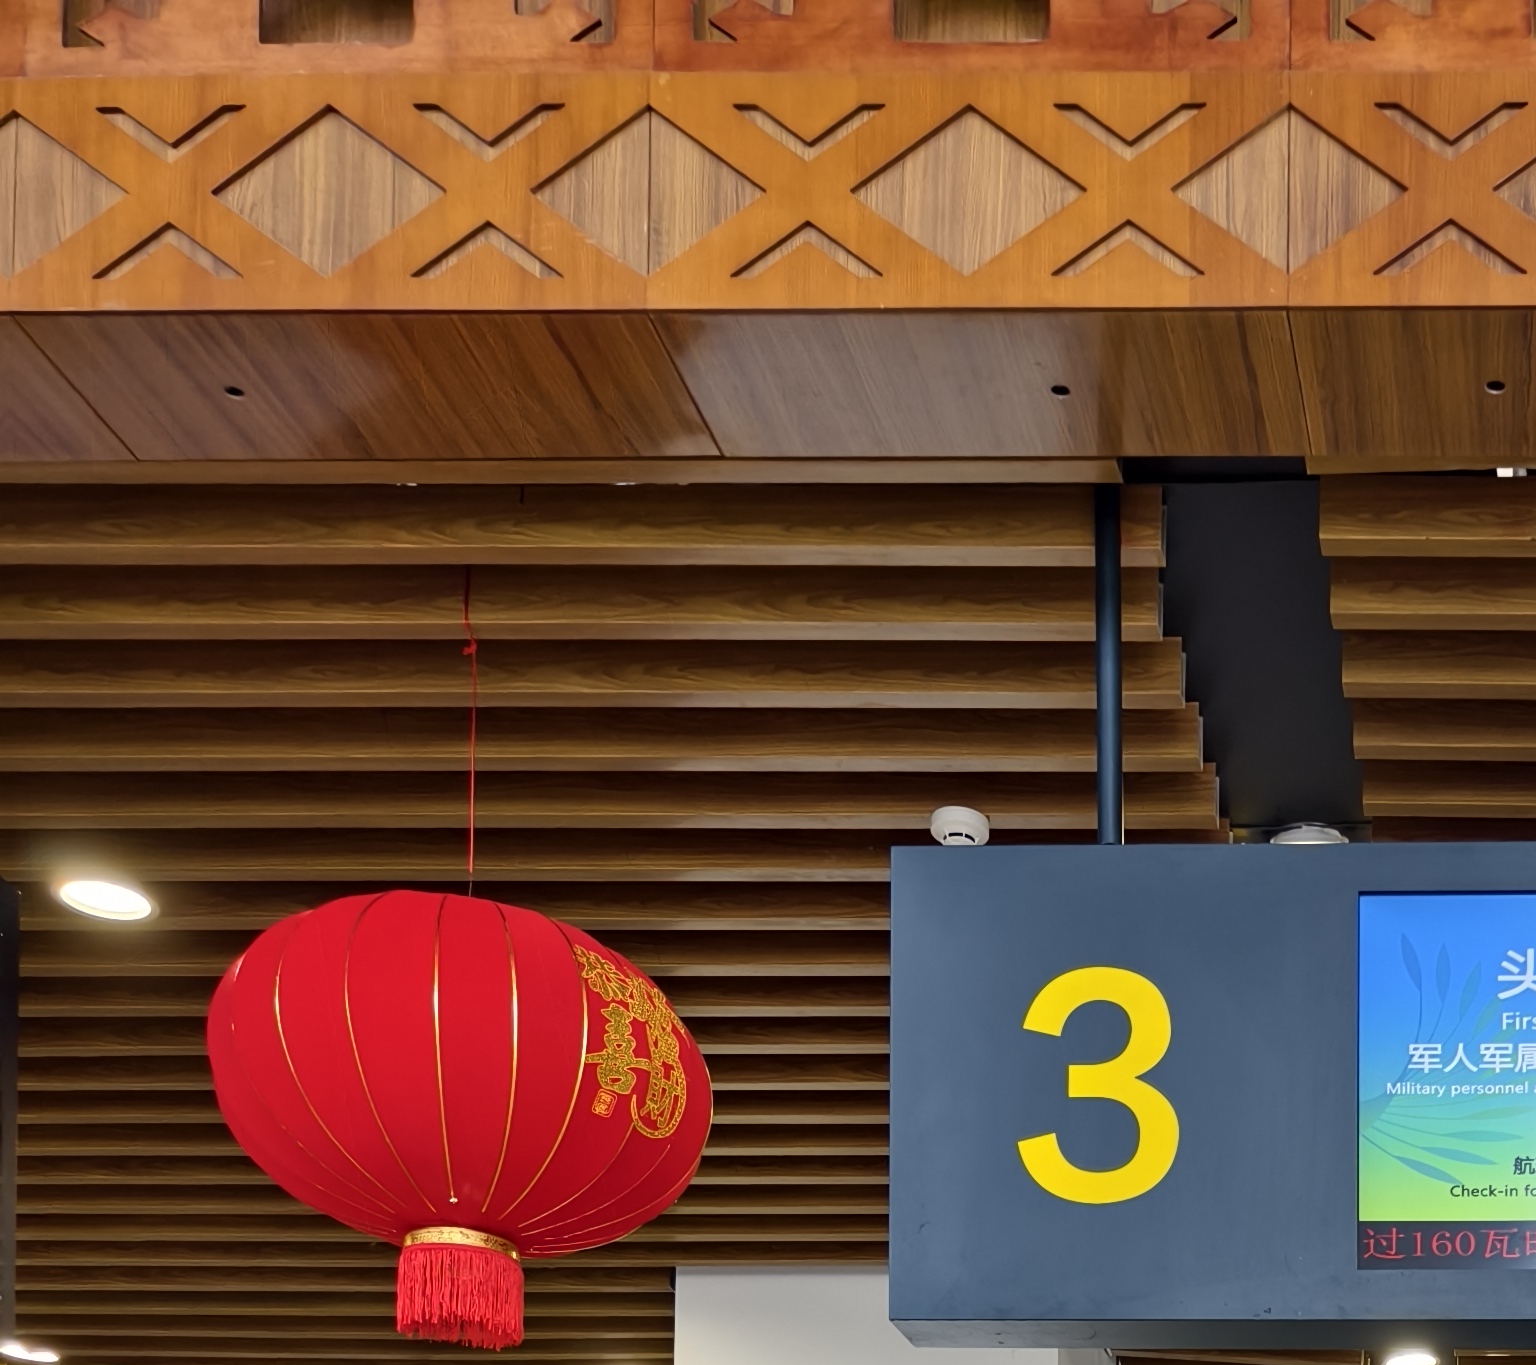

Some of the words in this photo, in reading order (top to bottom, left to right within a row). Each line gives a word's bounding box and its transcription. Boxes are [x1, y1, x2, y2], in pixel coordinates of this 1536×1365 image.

[1017, 966, 1180, 1205] 3
[1386, 1081, 1446, 1098] Military
[1451, 1081, 1529, 1098] personnel
[1449, 1184, 1519, 1198] Check-in
